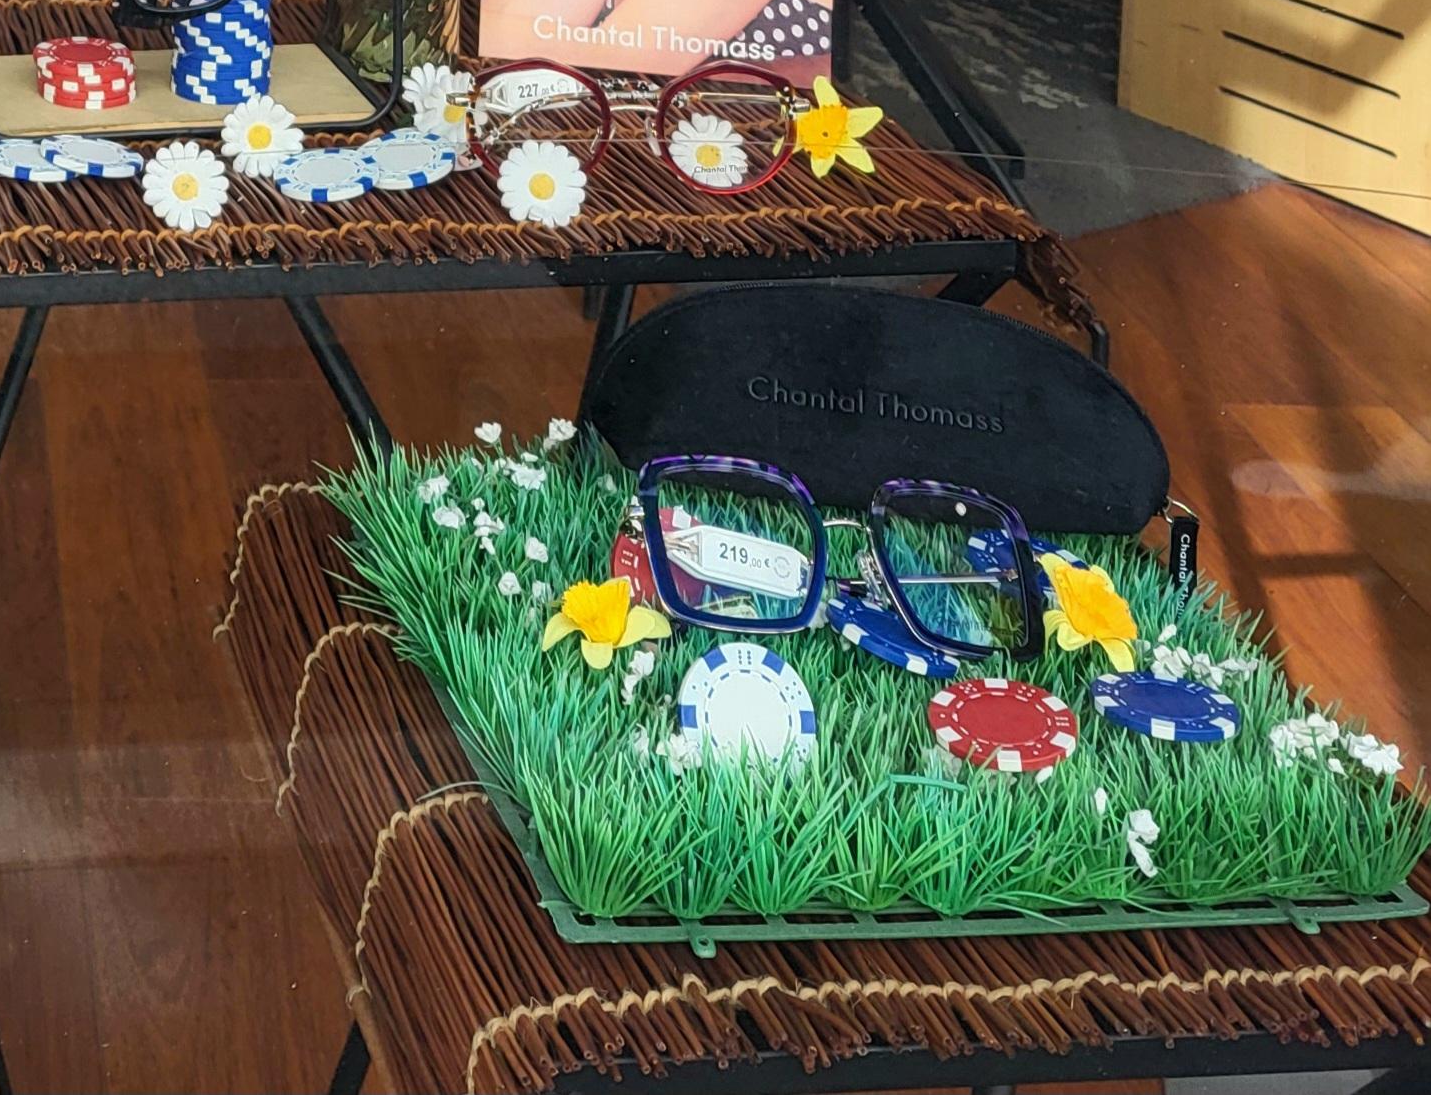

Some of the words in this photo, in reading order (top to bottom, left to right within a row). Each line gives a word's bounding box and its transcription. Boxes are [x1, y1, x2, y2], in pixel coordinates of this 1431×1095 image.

[532, 14, 643, 49] Chantal
[651, 25, 776, 62] Thomass
[694, 165, 727, 174] Chantal
[747, 375, 865, 415] Chantal
[871, 392, 1004, 434] Thomass
[1178, 533, 1191, 583] Chantal
